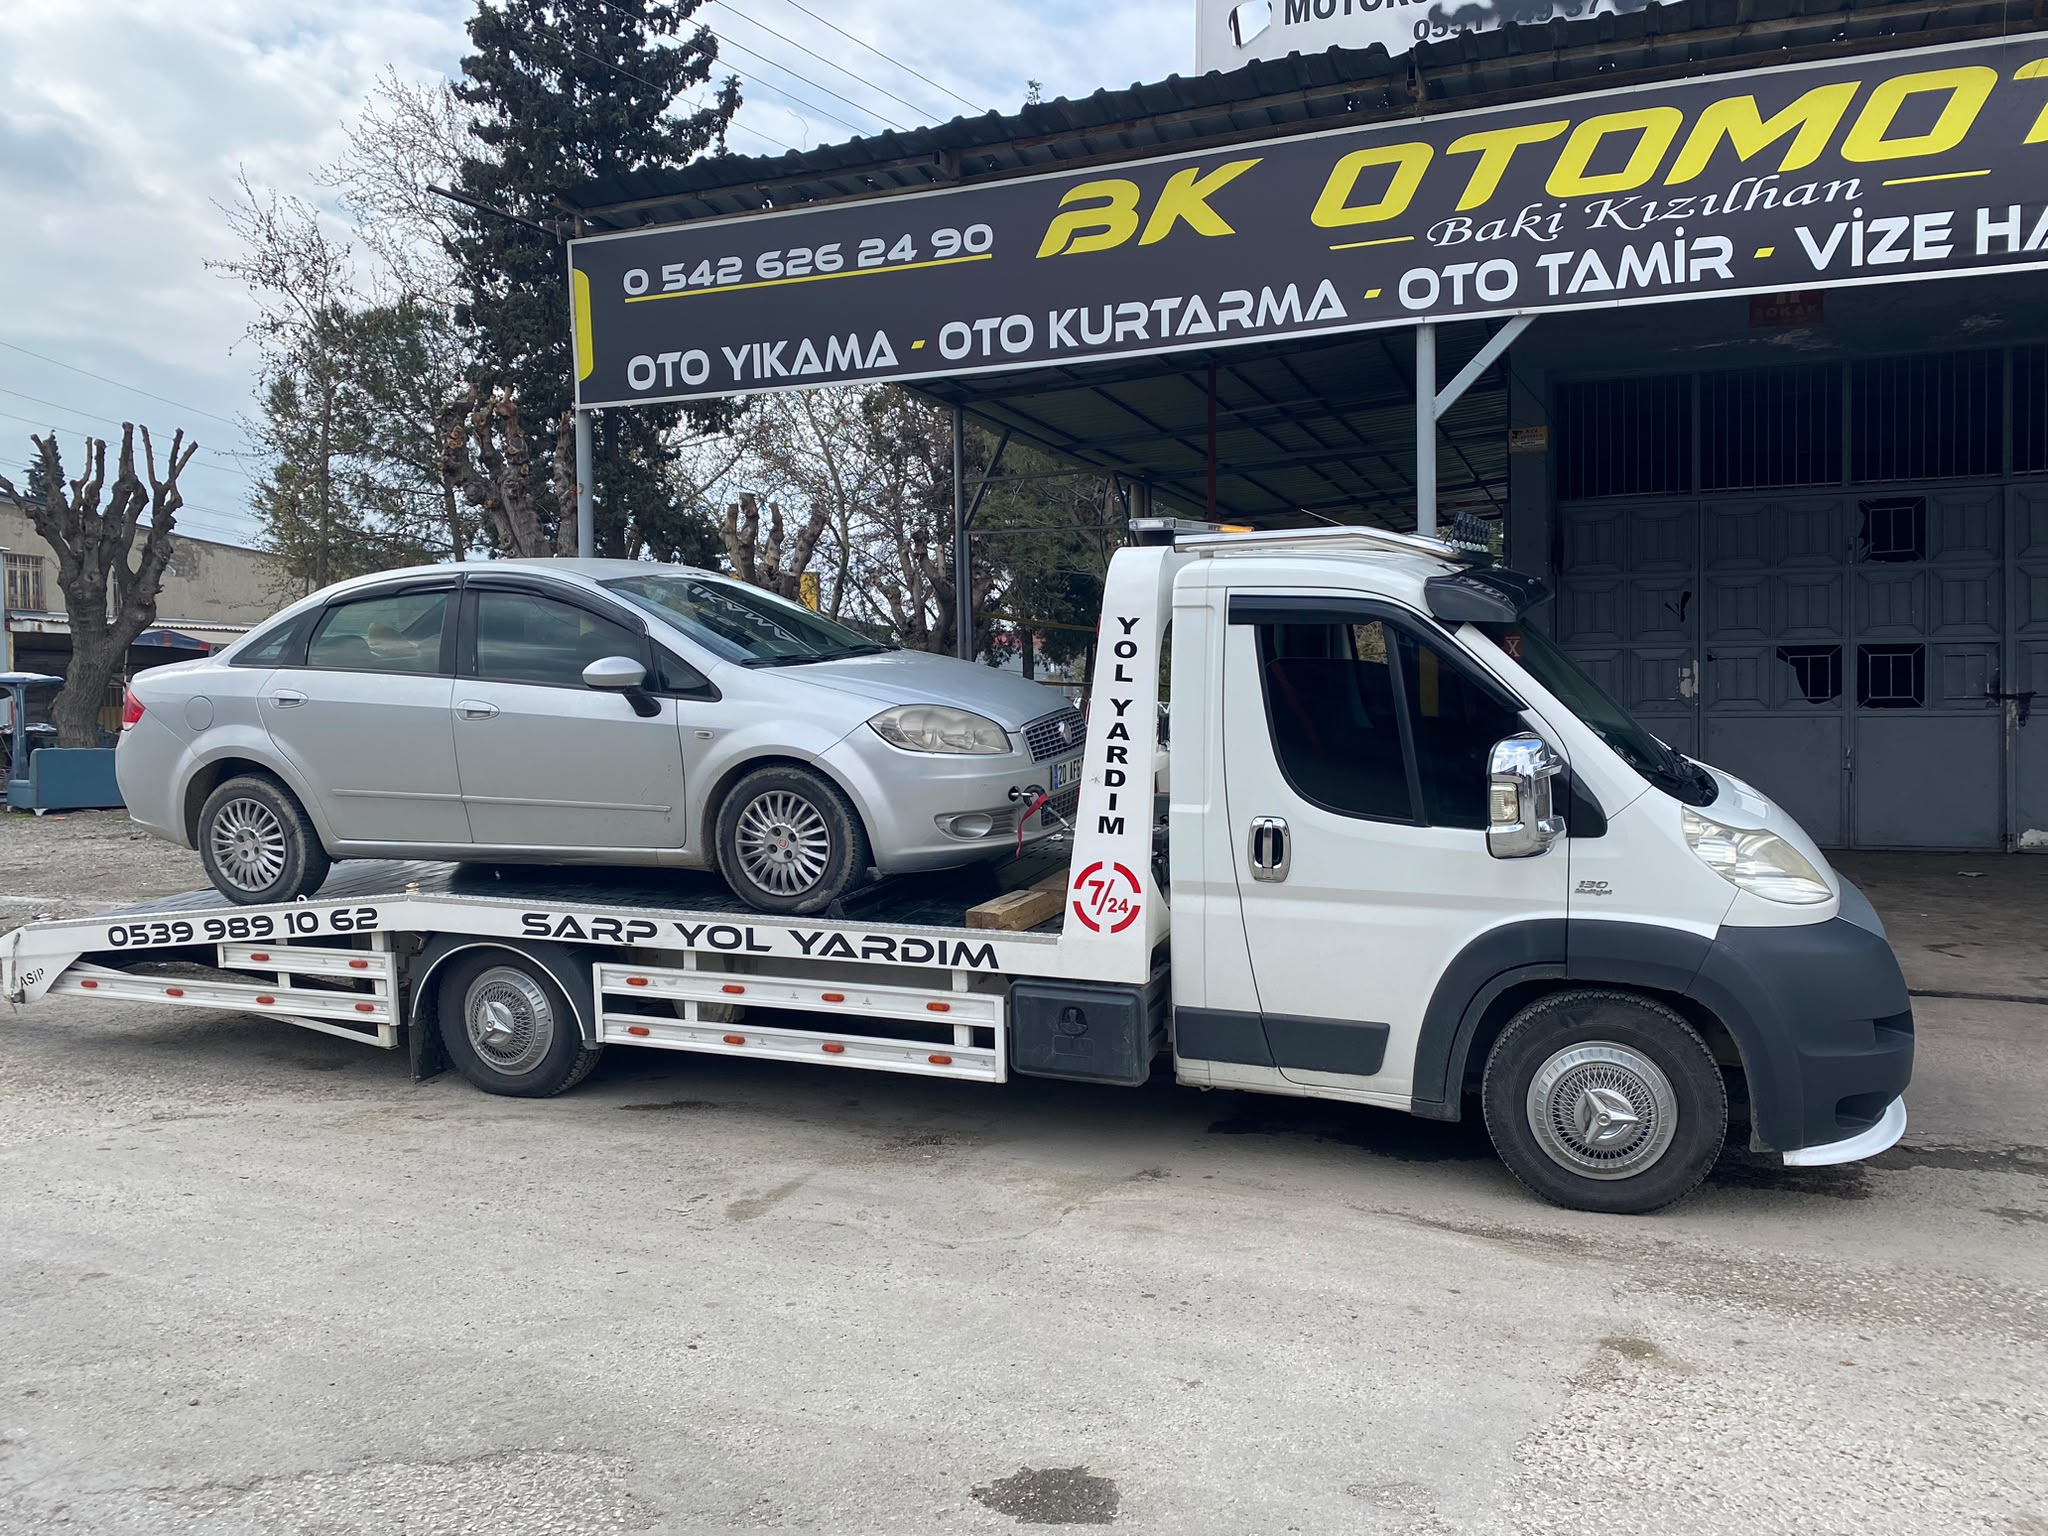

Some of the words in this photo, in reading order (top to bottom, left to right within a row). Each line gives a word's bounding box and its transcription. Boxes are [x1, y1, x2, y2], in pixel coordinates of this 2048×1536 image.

[1035, 158, 1264, 259] BK
[1311, 57, 2048, 228] OTOMO
[1426, 202, 1567, 247] Baki
[623, 268, 649, 296] 0
[662, 257, 743, 291] 542
[755, 243, 844, 279] 626
[858, 233, 918, 267] 24
[930, 223, 994, 258] 90
[627, 349, 710, 390] OTO
[721, 330, 899, 381] YIKAMA
[938, 314, 1034, 360] OTO
[1049, 279, 1348, 349] KURTARMA
[1399, 258, 1518, 310] OTO
[1536, 227, 1735, 295] TAMİR
[1794, 207, 1955, 271] VİZE
[1113, 616, 1140, 682] YOL
[1058, 763, 1067, 785] 20
[1098, 698, 1134, 835] YARDIM
[108, 921, 194, 947] 0539
[203, 915, 274, 940] 989
[283, 911, 319, 934] 10
[330, 907, 379, 931] 62
[1088, 879, 1129, 916] 7/24
[521, 913, 658, 943] SARP
[674, 922, 773, 952] YOL
[787, 929, 999, 969] YARDIM
